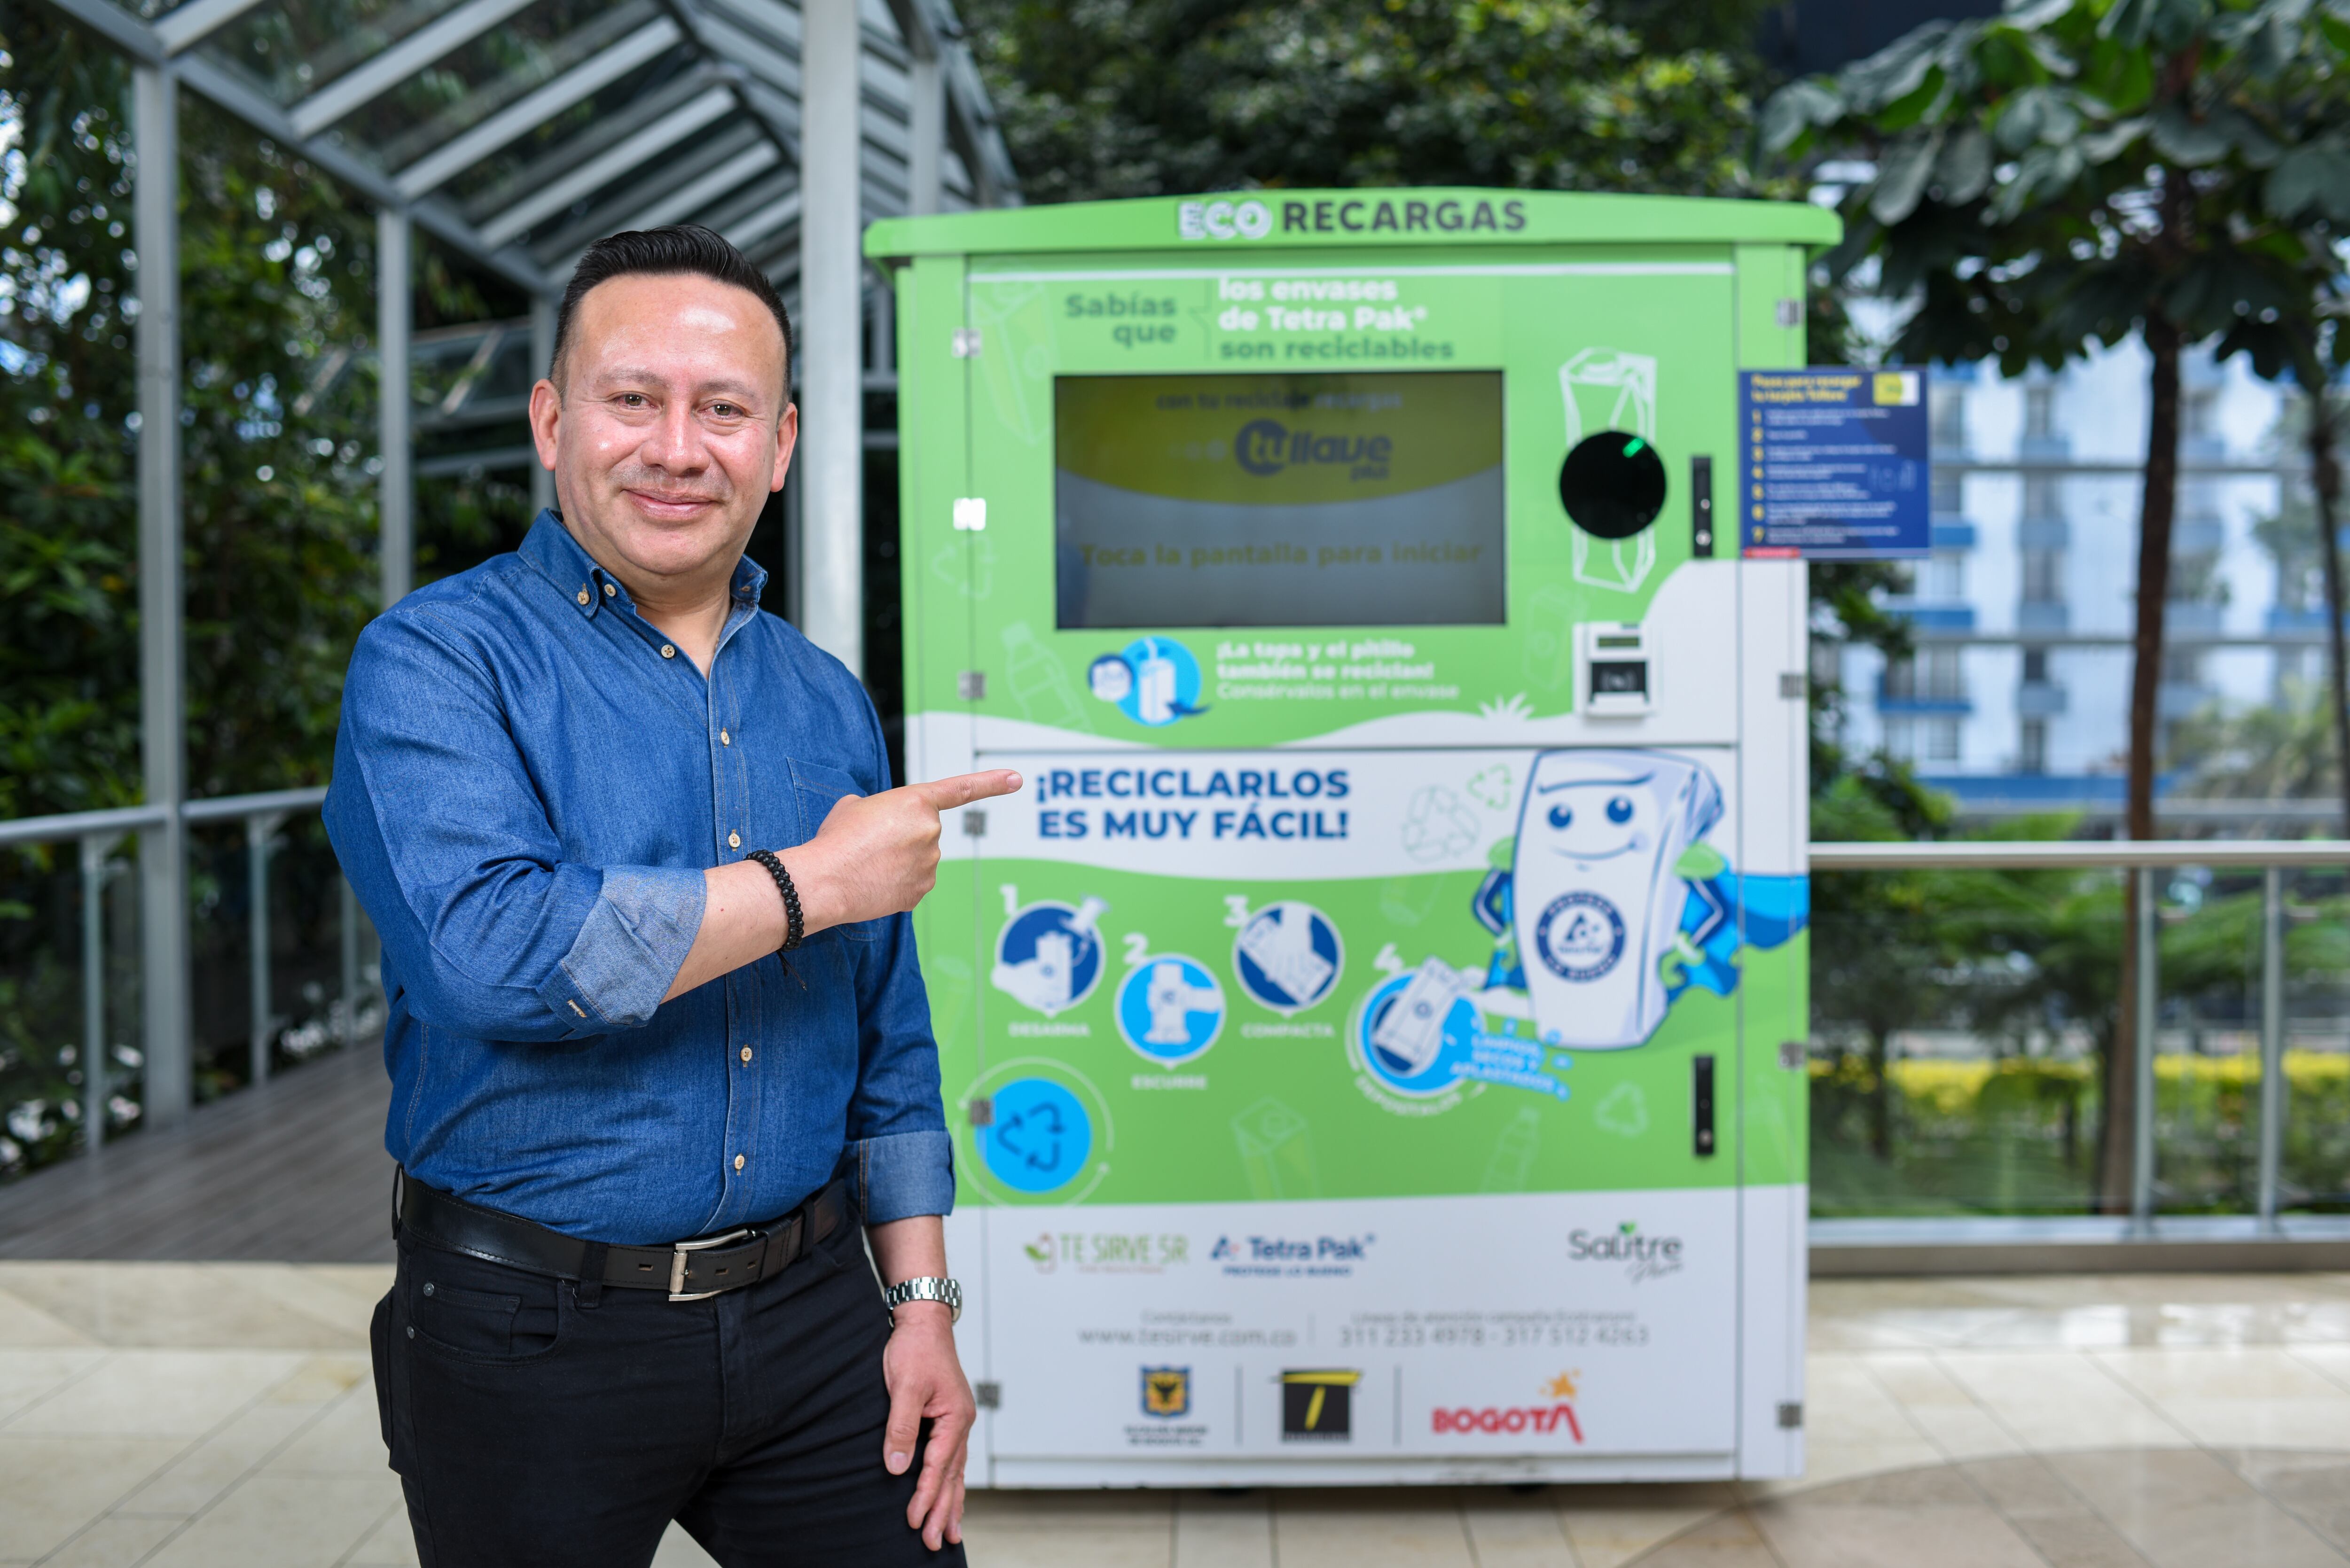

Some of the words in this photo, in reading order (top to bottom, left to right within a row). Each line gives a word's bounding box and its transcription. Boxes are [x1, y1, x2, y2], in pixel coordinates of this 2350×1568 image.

[1177, 200, 1272, 240] ECO
[1283, 199, 1526, 233] RECARGAS
[1219, 276, 1264, 301] los
[1272, 281, 1397, 301] envases
[1065, 293, 1176, 318] Sabías
[1219, 306, 1258, 331] de
[1266, 306, 1346, 330] Tetra
[1113, 322, 1176, 347] que
[1220, 339, 1276, 360] son
[1286, 335, 1453, 360] reciclables
[1081, 544, 1146, 565] Toca
[1155, 543, 1181, 564] la
[1191, 542, 1308, 569] pantalla
[1318, 544, 1382, 569] para
[1392, 540, 1484, 563] iniciar
[1254, 642, 1303, 661] tapa
[1307, 644, 1322, 661] y
[1325, 640, 1347, 658] el
[1311, 663, 1337, 679] se
[1339, 686, 1364, 699] en
[1369, 683, 1387, 699] el
[1036, 769, 1350, 804] ¡RECICLARLOS
[1038, 810, 1089, 839] ES
[1104, 810, 1198, 839] MUY
[1214, 802, 1348, 840] FÁCIL!
[999, 883, 1018, 916] 1
[1223, 895, 1250, 927] 3
[1122, 932, 1149, 965] 2
[1247, 1236, 1311, 1262] Tetra
